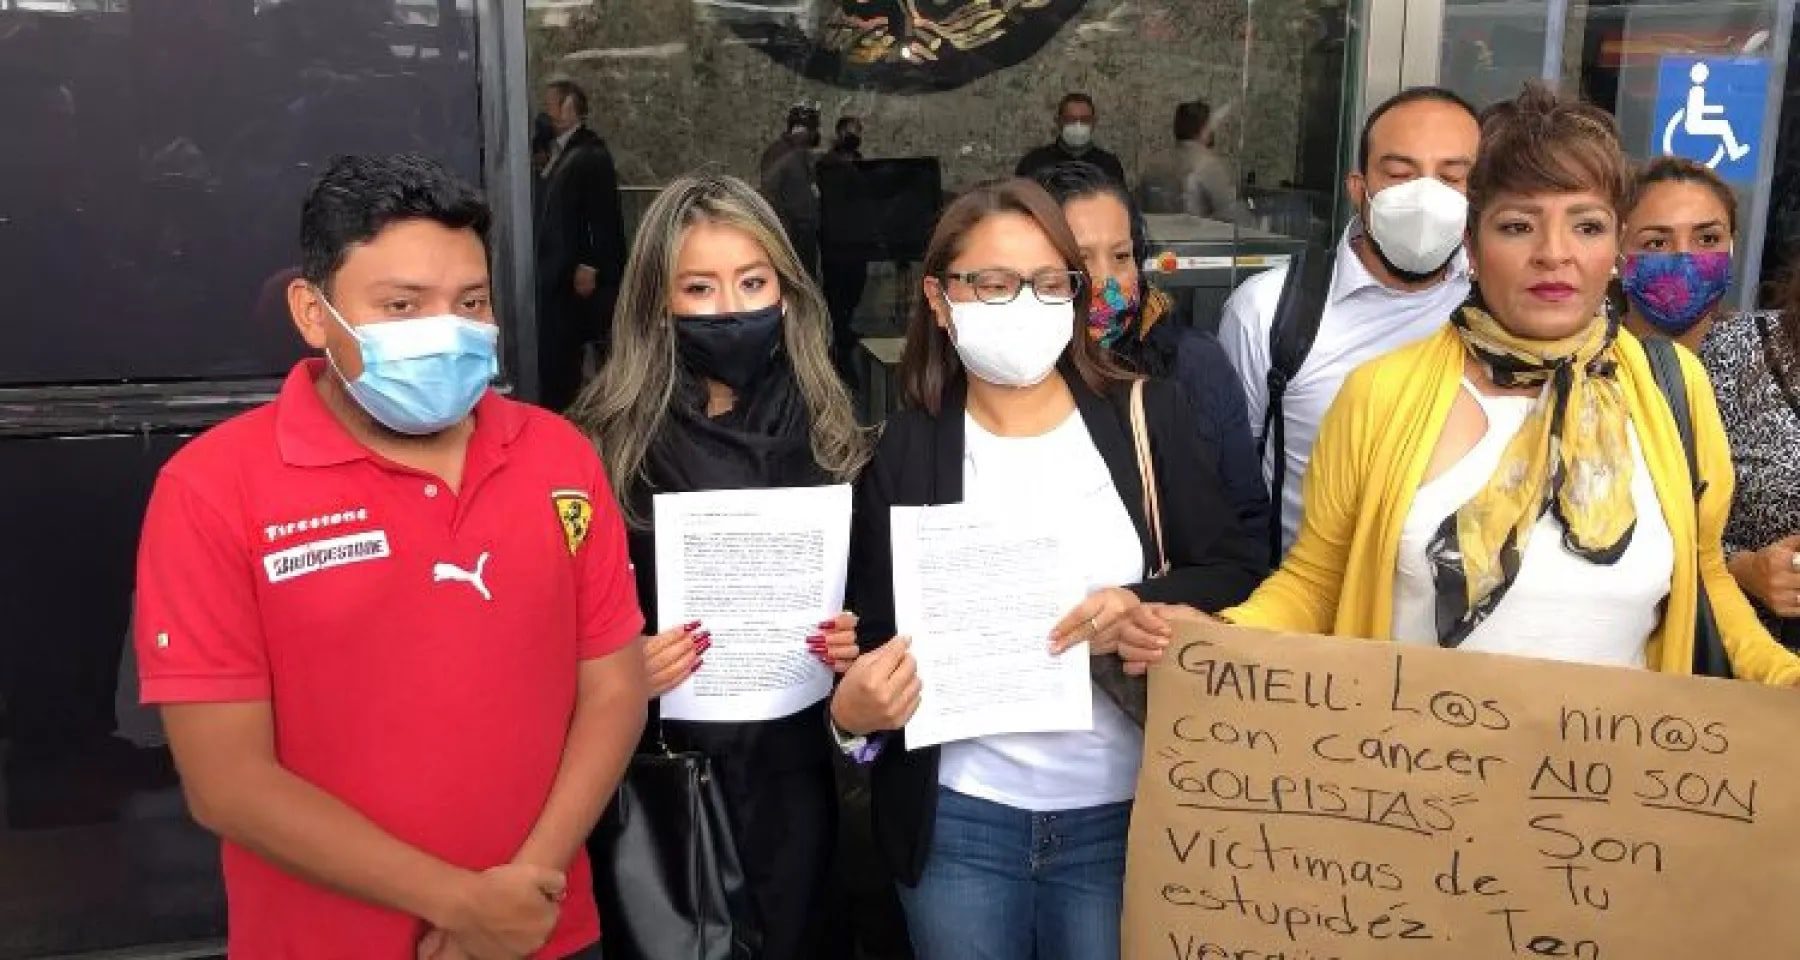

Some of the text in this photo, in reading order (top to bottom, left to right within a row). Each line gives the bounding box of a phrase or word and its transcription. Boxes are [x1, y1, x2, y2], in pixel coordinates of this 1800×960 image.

[1177, 641, 1363, 712] GATELL:
[1391, 654, 1510, 730] L@s
[1528, 755, 1612, 796] NO
[1634, 769, 1758, 817] SON
[1528, 813, 1662, 872] Son
[1434, 850, 1507, 896] de
[1543, 863, 1610, 911] Tu
